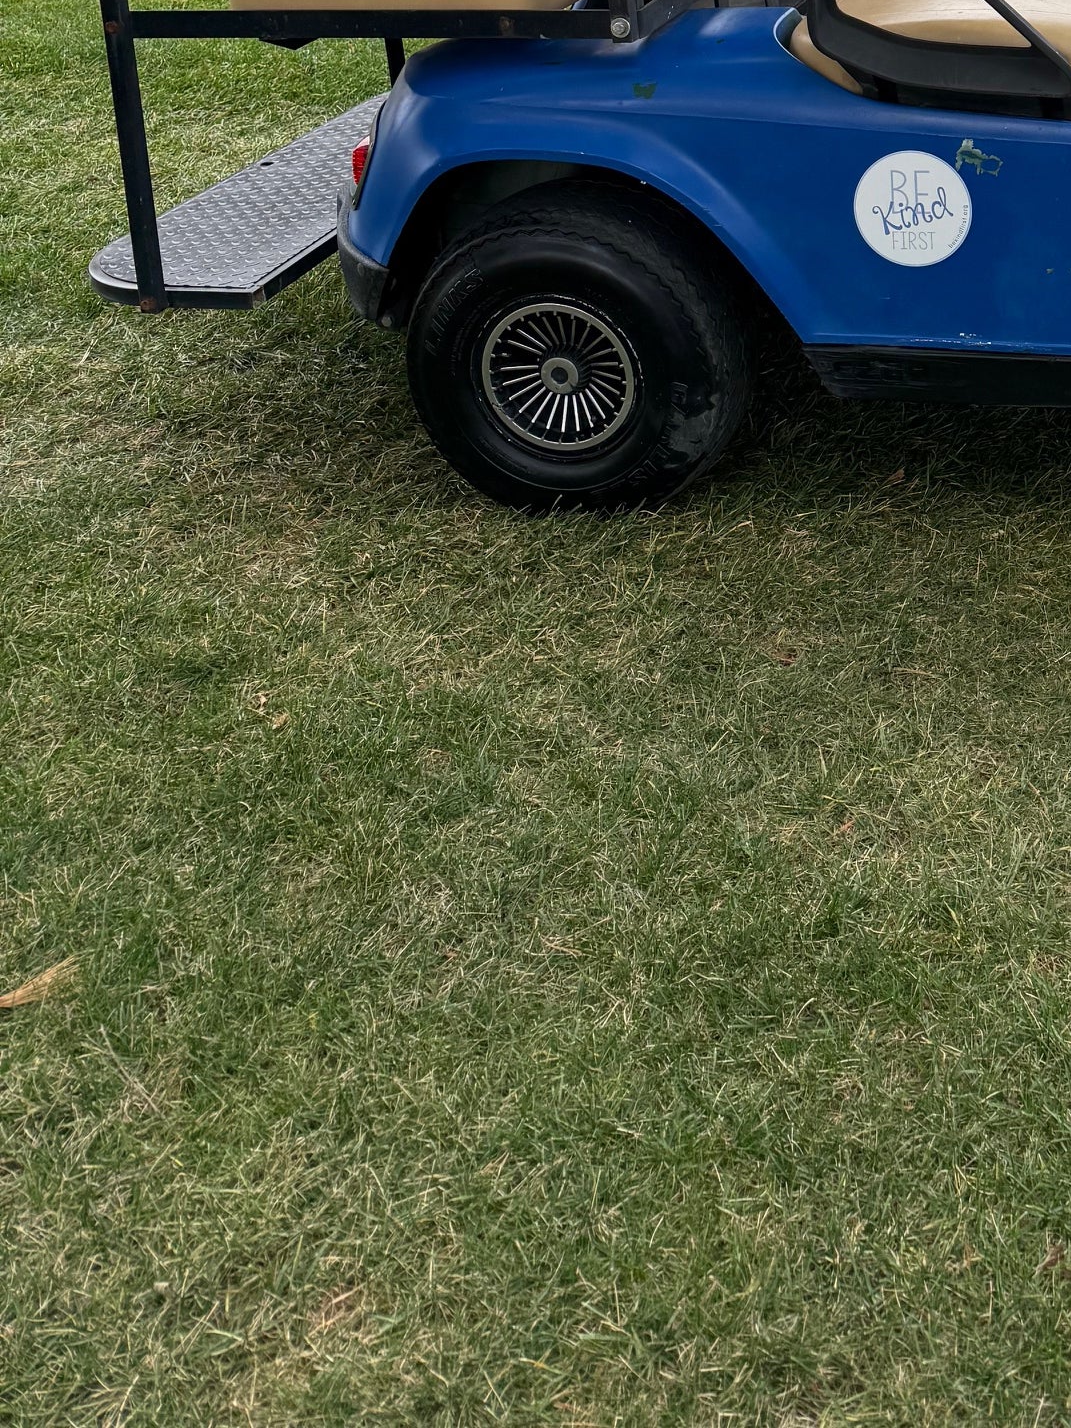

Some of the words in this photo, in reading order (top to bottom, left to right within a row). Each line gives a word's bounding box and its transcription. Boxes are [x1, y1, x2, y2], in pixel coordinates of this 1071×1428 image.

[872, 187, 954, 235] Kind
[890, 170, 931, 215] BE
[892, 231, 937, 250] FIRST
